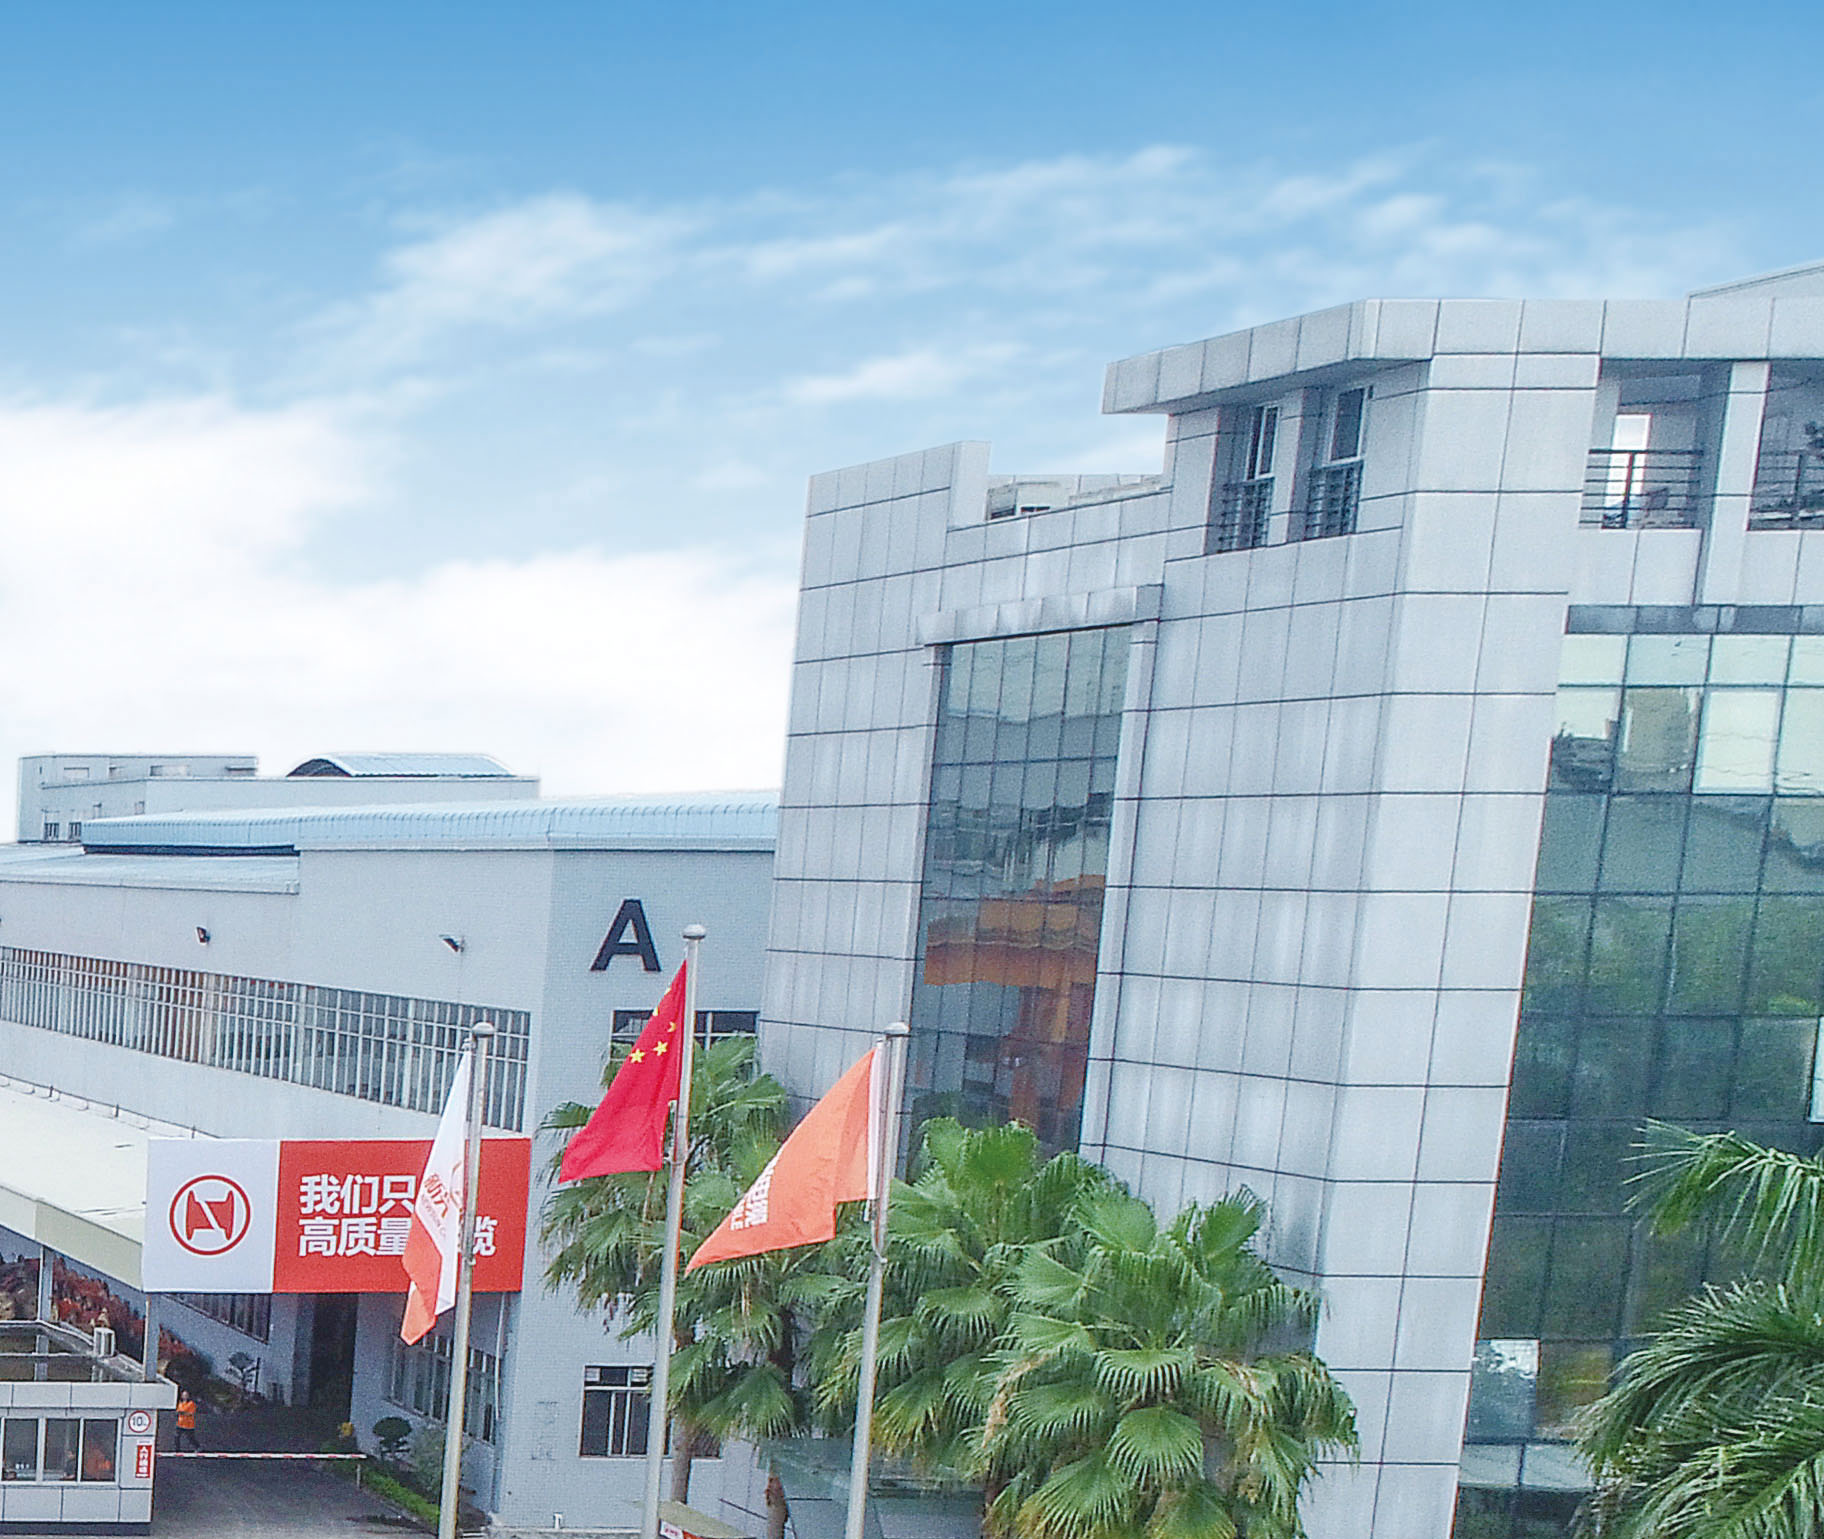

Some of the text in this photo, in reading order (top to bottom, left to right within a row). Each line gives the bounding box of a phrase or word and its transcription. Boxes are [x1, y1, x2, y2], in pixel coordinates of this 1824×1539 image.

[590, 898, 662, 972] A
[297, 1173, 416, 1214] 我们只
[297, 1216, 497, 1257] 高质量缆
